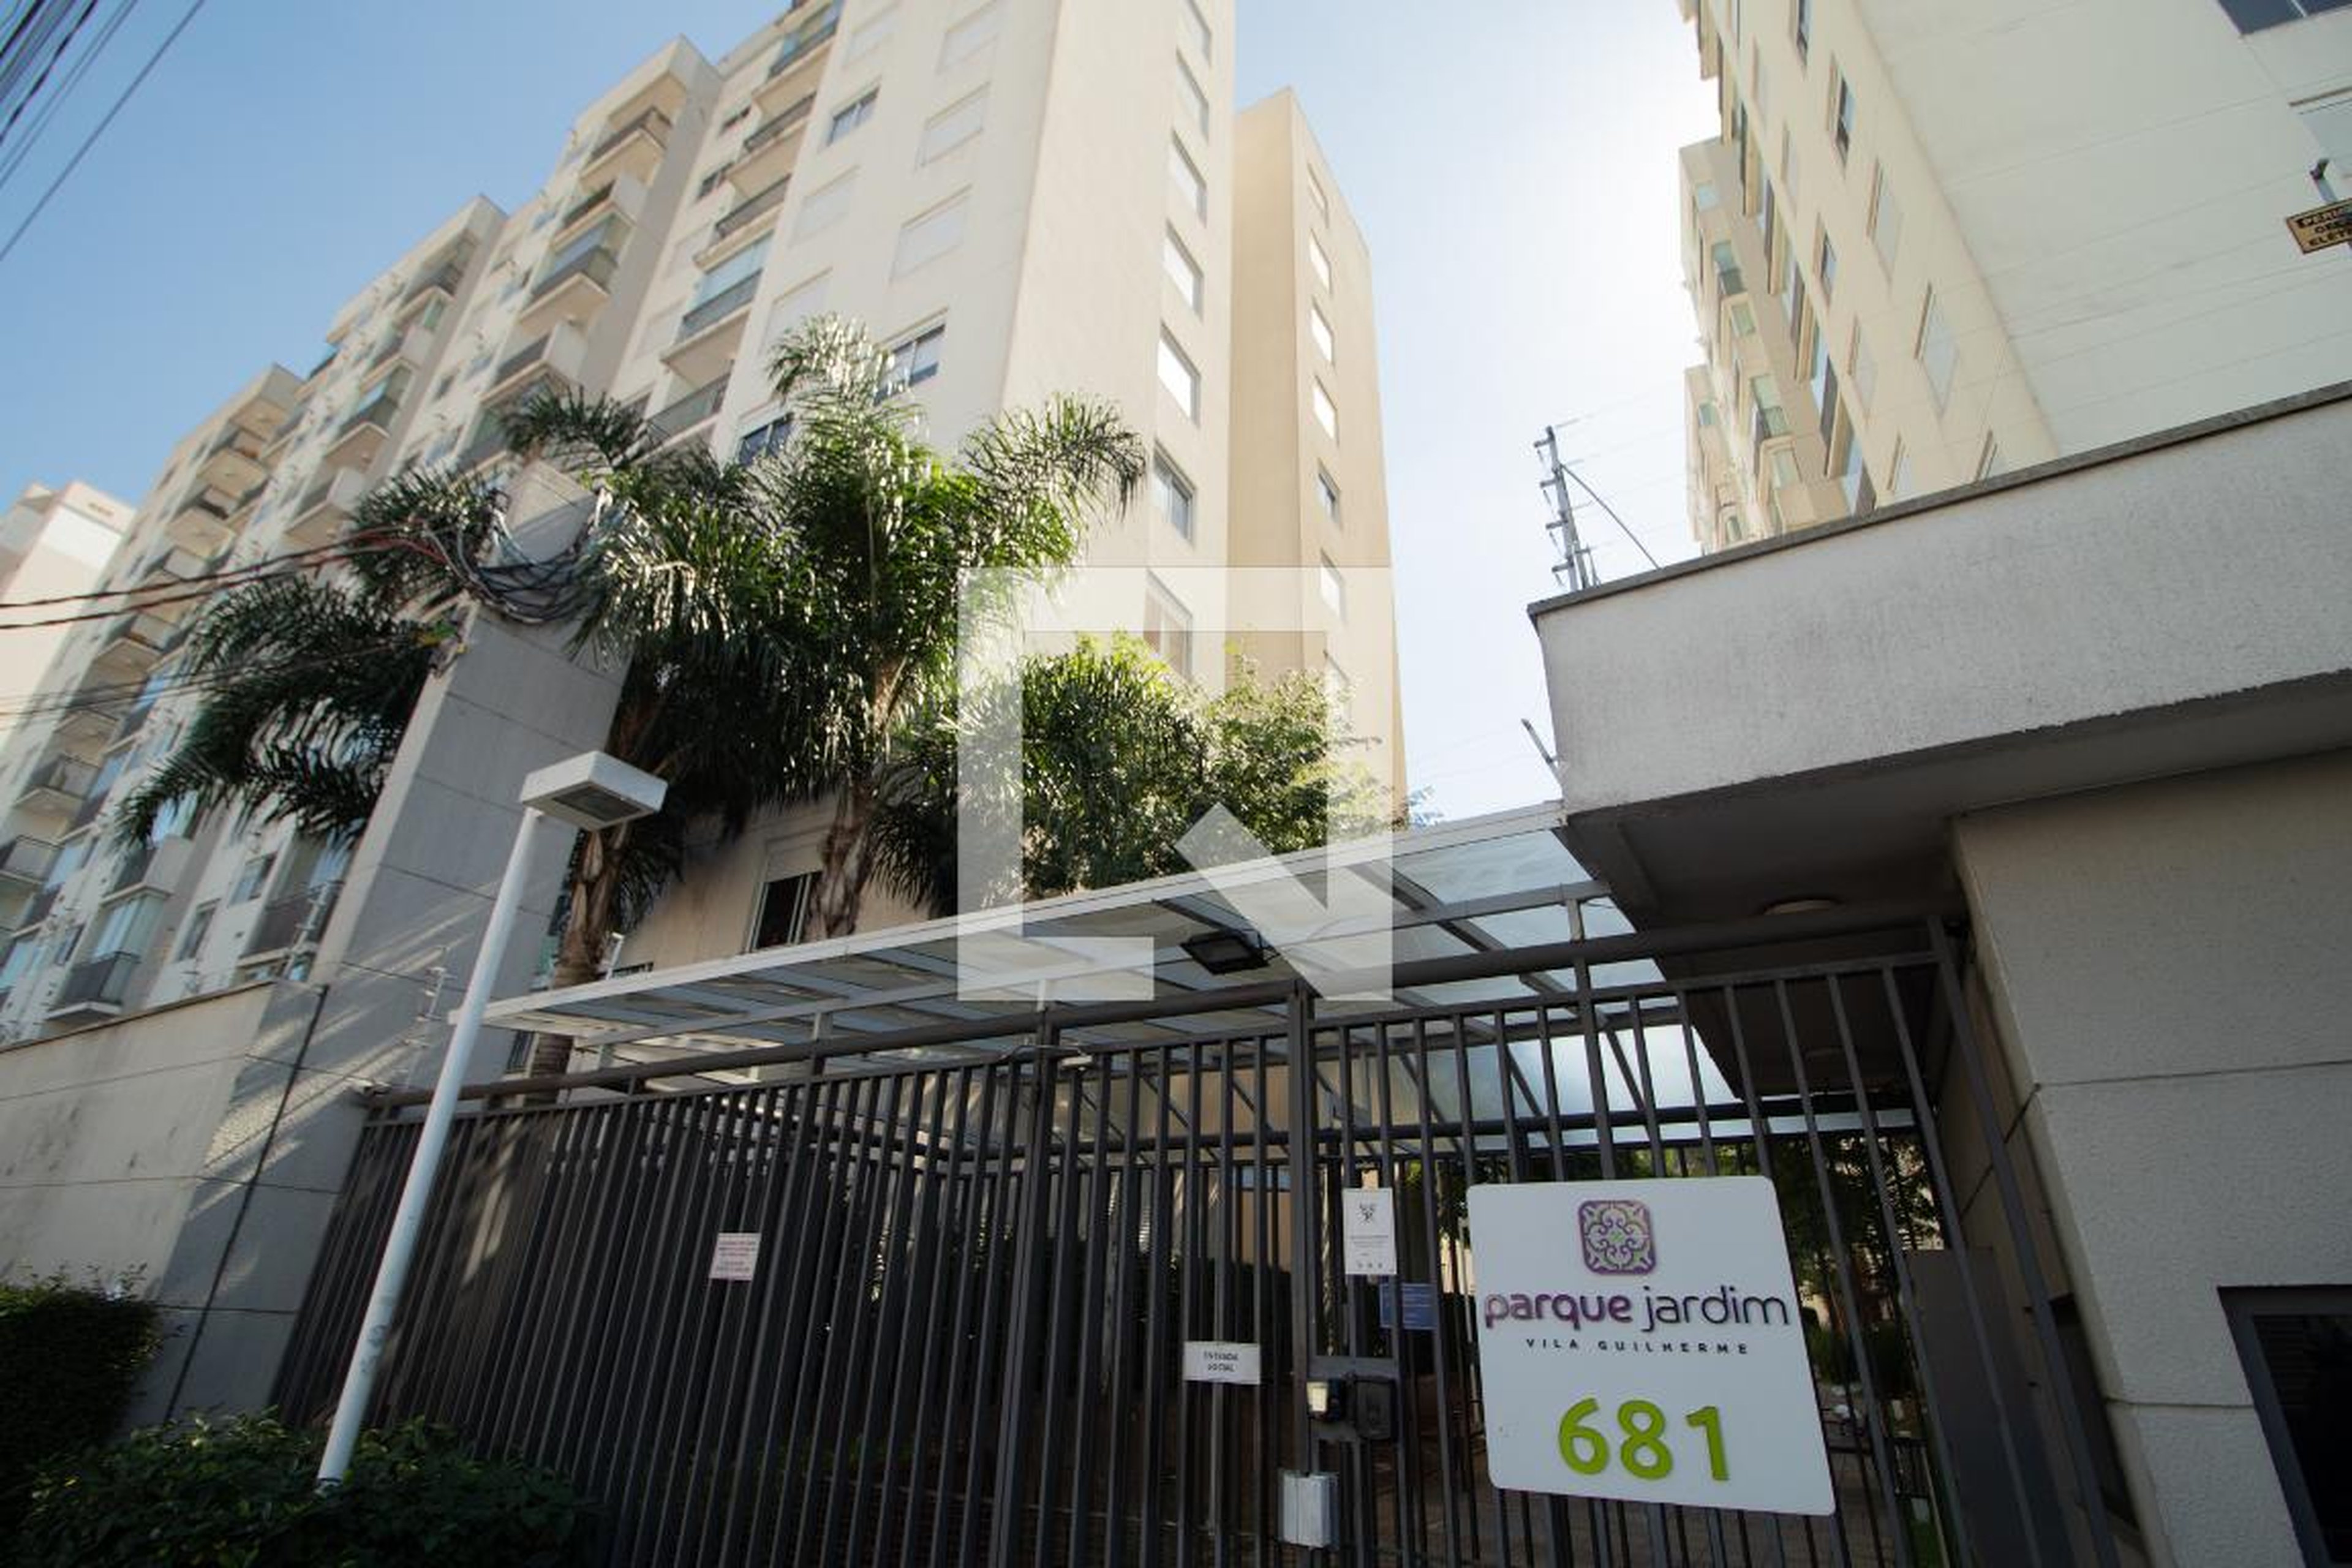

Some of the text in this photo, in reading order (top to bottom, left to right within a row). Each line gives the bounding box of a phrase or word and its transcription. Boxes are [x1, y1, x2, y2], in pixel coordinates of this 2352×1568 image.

[1483, 1293, 1634, 1332] parque
[1640, 1284, 1790, 1334] jardim
[1526, 1338, 1747, 1355] VILA GUILHERME
[1558, 1398, 1731, 1482] 681
